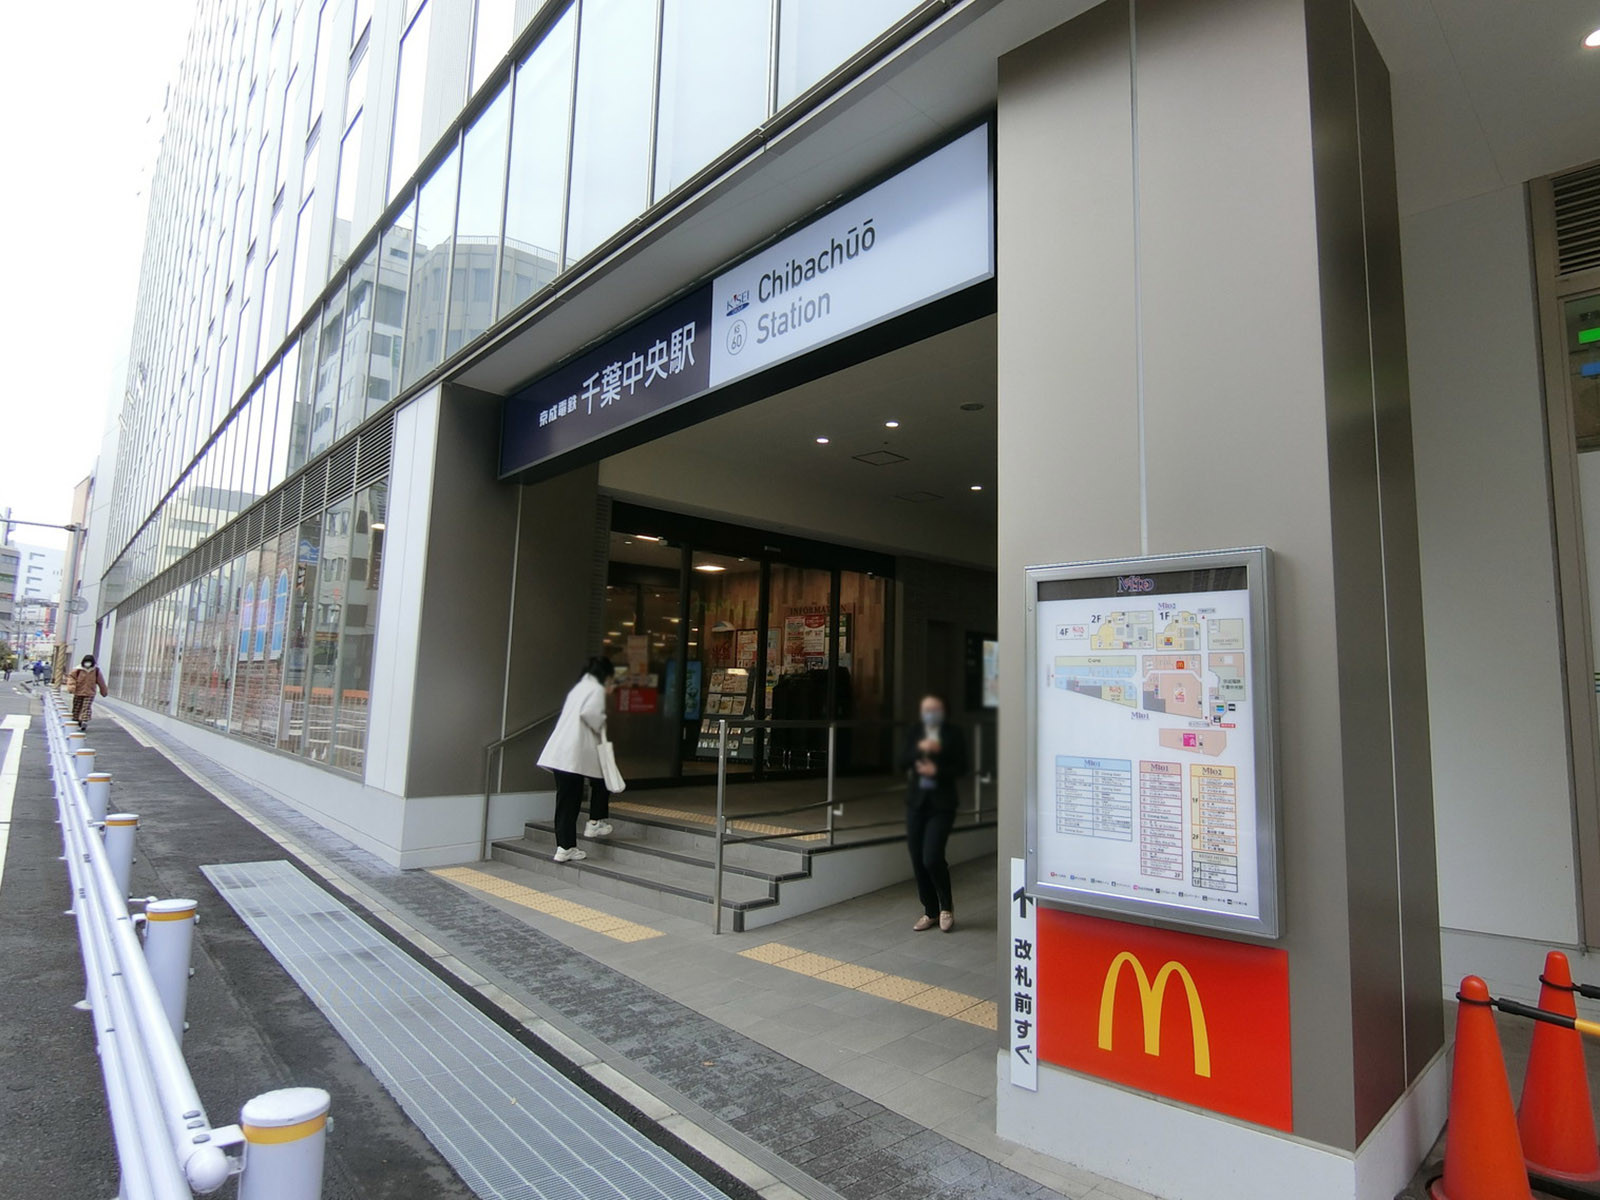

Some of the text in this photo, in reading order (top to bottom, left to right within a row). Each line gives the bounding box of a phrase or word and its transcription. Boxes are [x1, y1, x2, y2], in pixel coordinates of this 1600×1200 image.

[758, 218, 876, 304] Chibachūō
[756, 292, 831, 344] Station
[731, 334, 742, 350] 60
[539, 321, 696, 427] 京成電鉄 千葉中央駅
[1059, 628, 1069, 636] 4F
[1091, 615, 1101, 624] 2F
[1160, 612, 1170, 620] 1F
[1014, 938, 1032, 1066] 改札前すぐ
